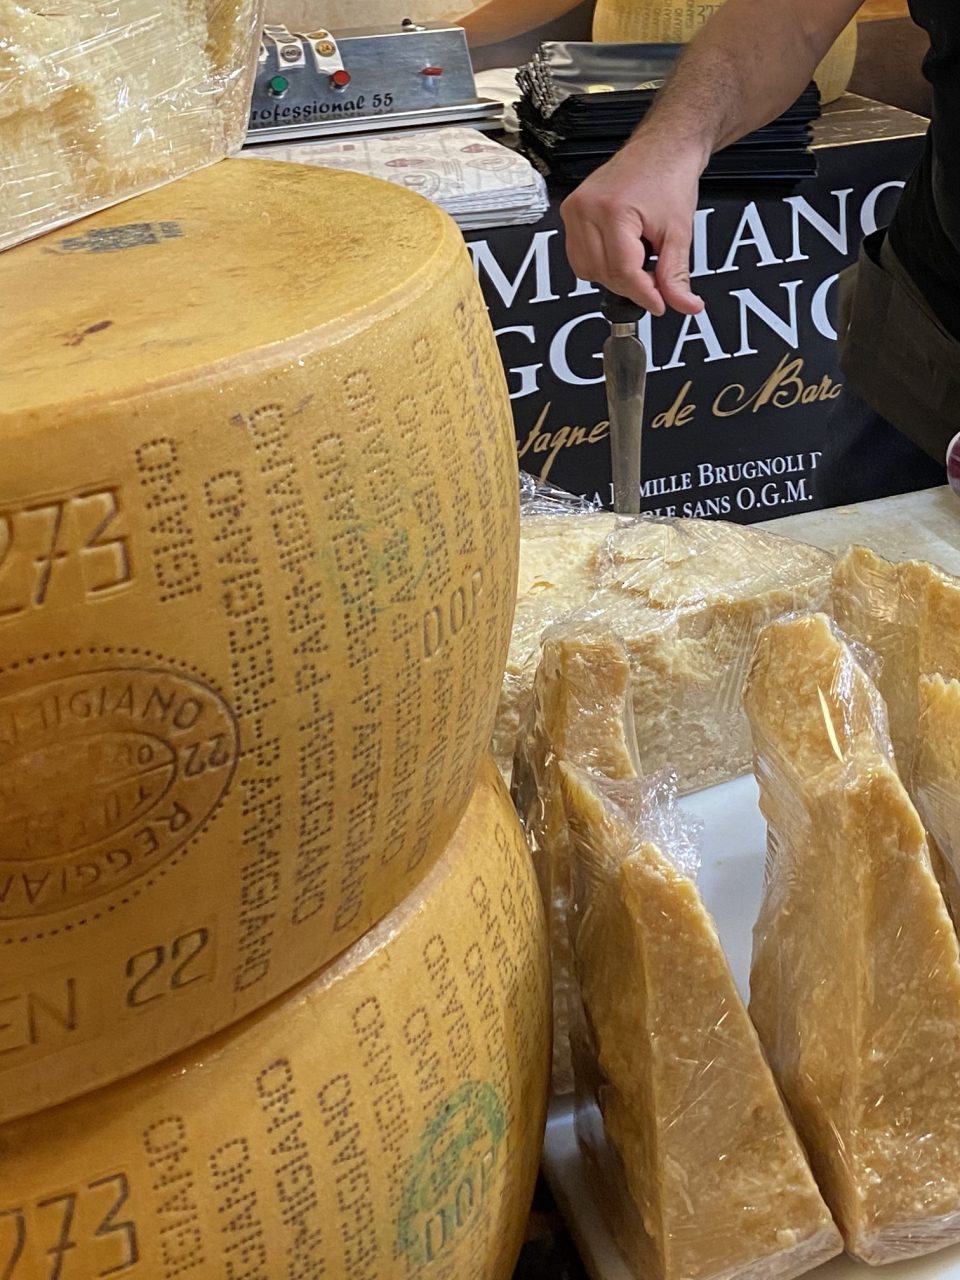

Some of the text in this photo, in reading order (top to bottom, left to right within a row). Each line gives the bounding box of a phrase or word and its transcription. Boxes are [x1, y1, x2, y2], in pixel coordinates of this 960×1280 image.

[372, 93, 394, 108] 55
[652, 380, 696, 431] de
[609, 472, 693, 506] MILLE
[697, 454, 805, 488] BRUGNOLI
[682, 495, 731, 519] SANS
[736, 479, 813, 511] O.G.M.
[124, 926, 210, 1009] 22
